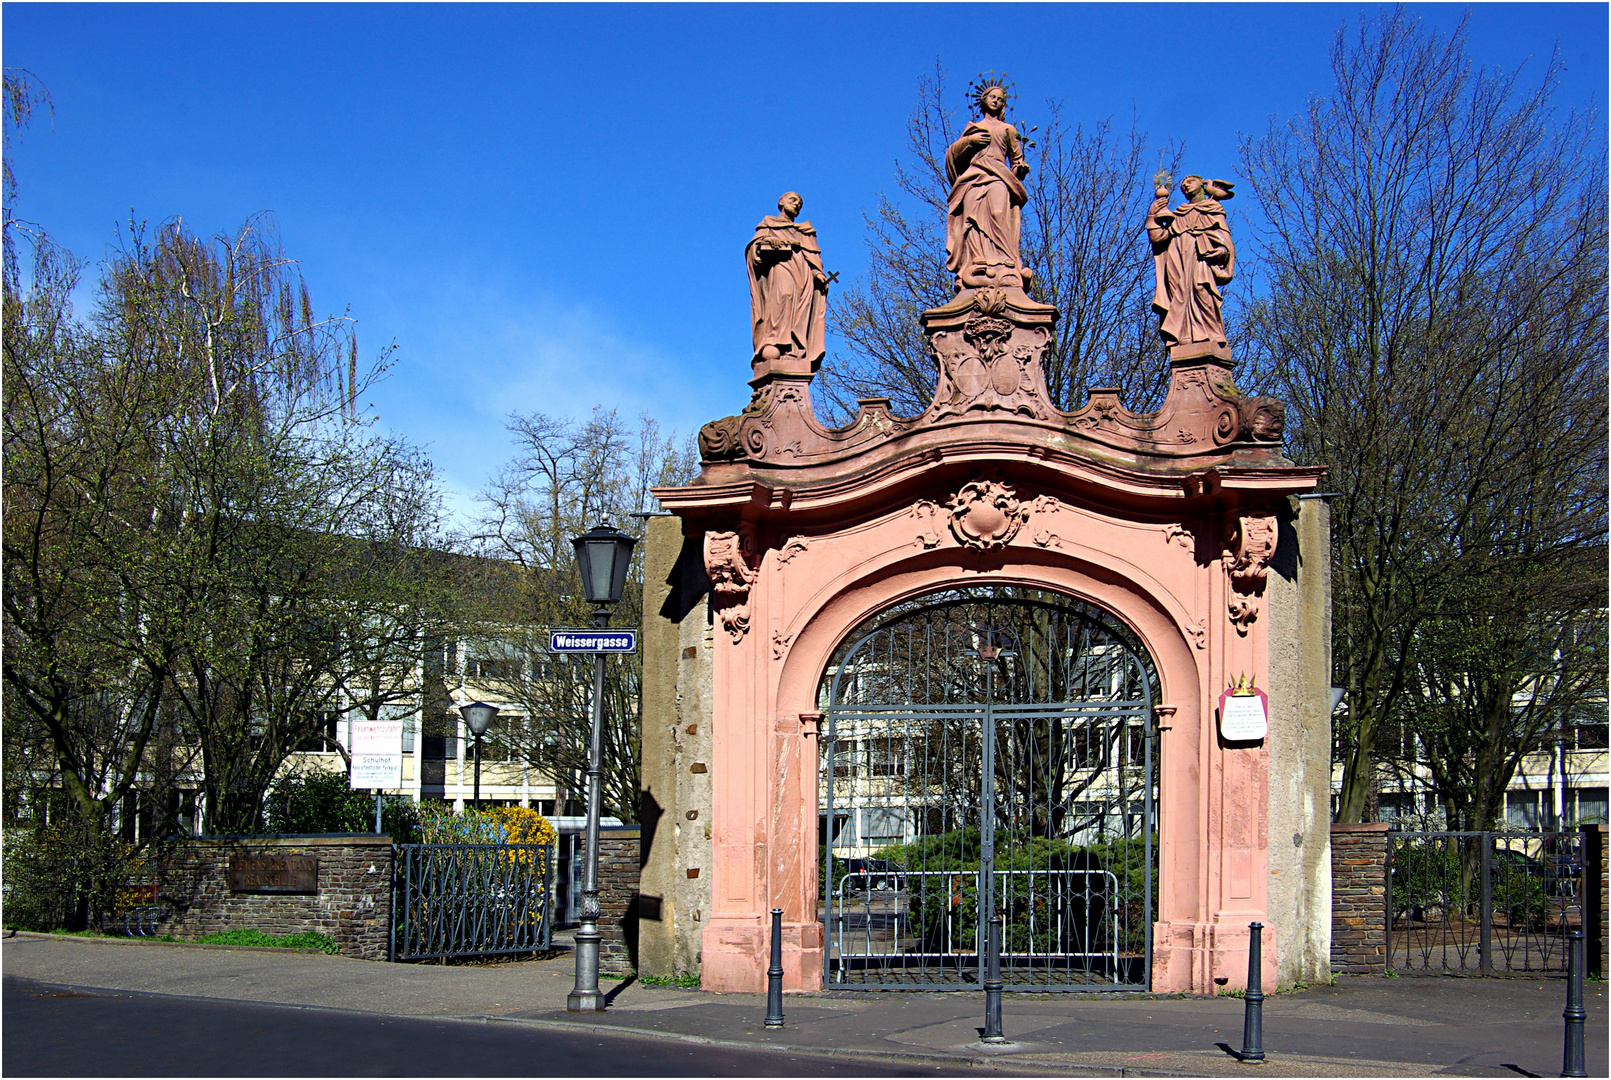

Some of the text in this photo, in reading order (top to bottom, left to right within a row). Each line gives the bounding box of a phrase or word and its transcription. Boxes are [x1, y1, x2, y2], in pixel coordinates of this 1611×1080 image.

[556, 635, 629, 650] Weissergasse
[270, 859, 315, 871] BRENTANO
[244, 874, 297, 886] REALSCHULE
